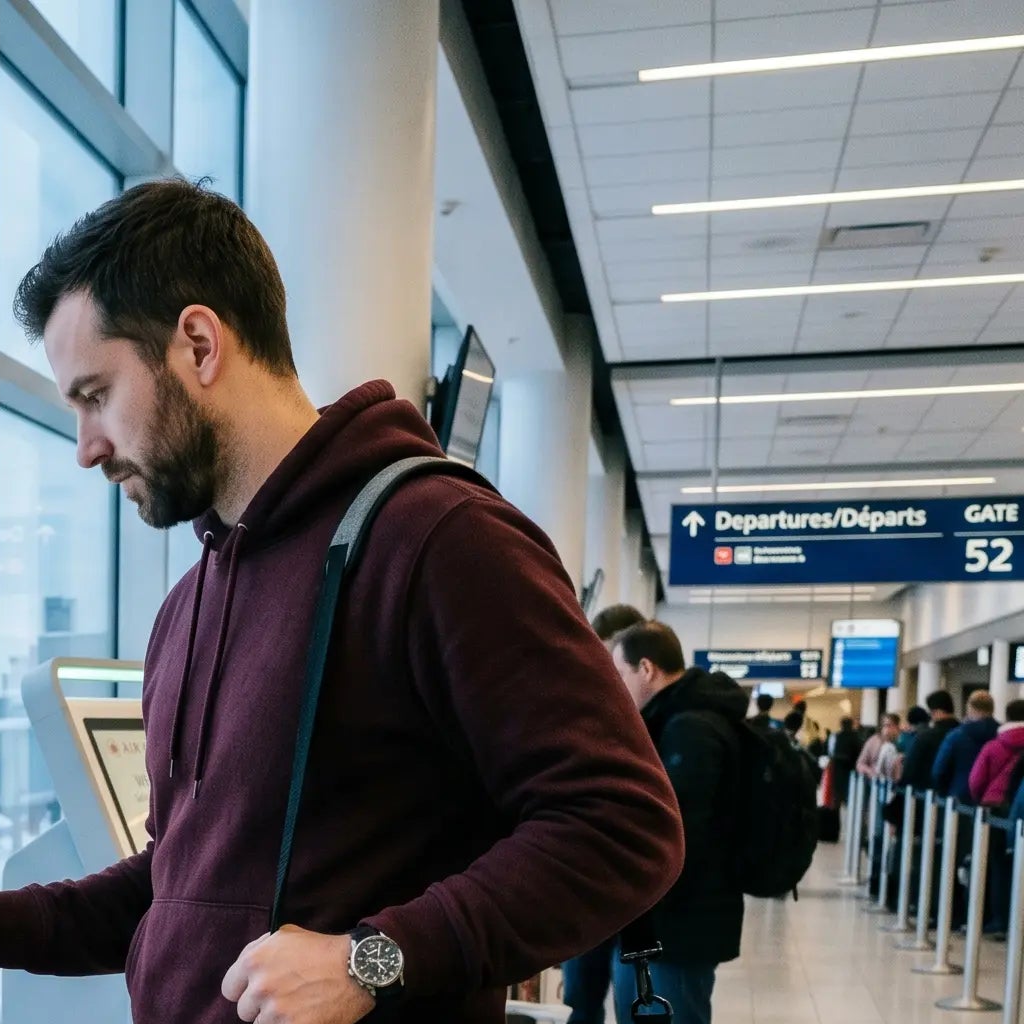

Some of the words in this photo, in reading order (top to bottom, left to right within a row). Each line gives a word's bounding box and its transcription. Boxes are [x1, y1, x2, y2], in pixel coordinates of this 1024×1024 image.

[714, 505, 927, 536] Departures/Départs
[964, 503, 1019, 524] GATE
[964, 538, 1014, 573] 52
